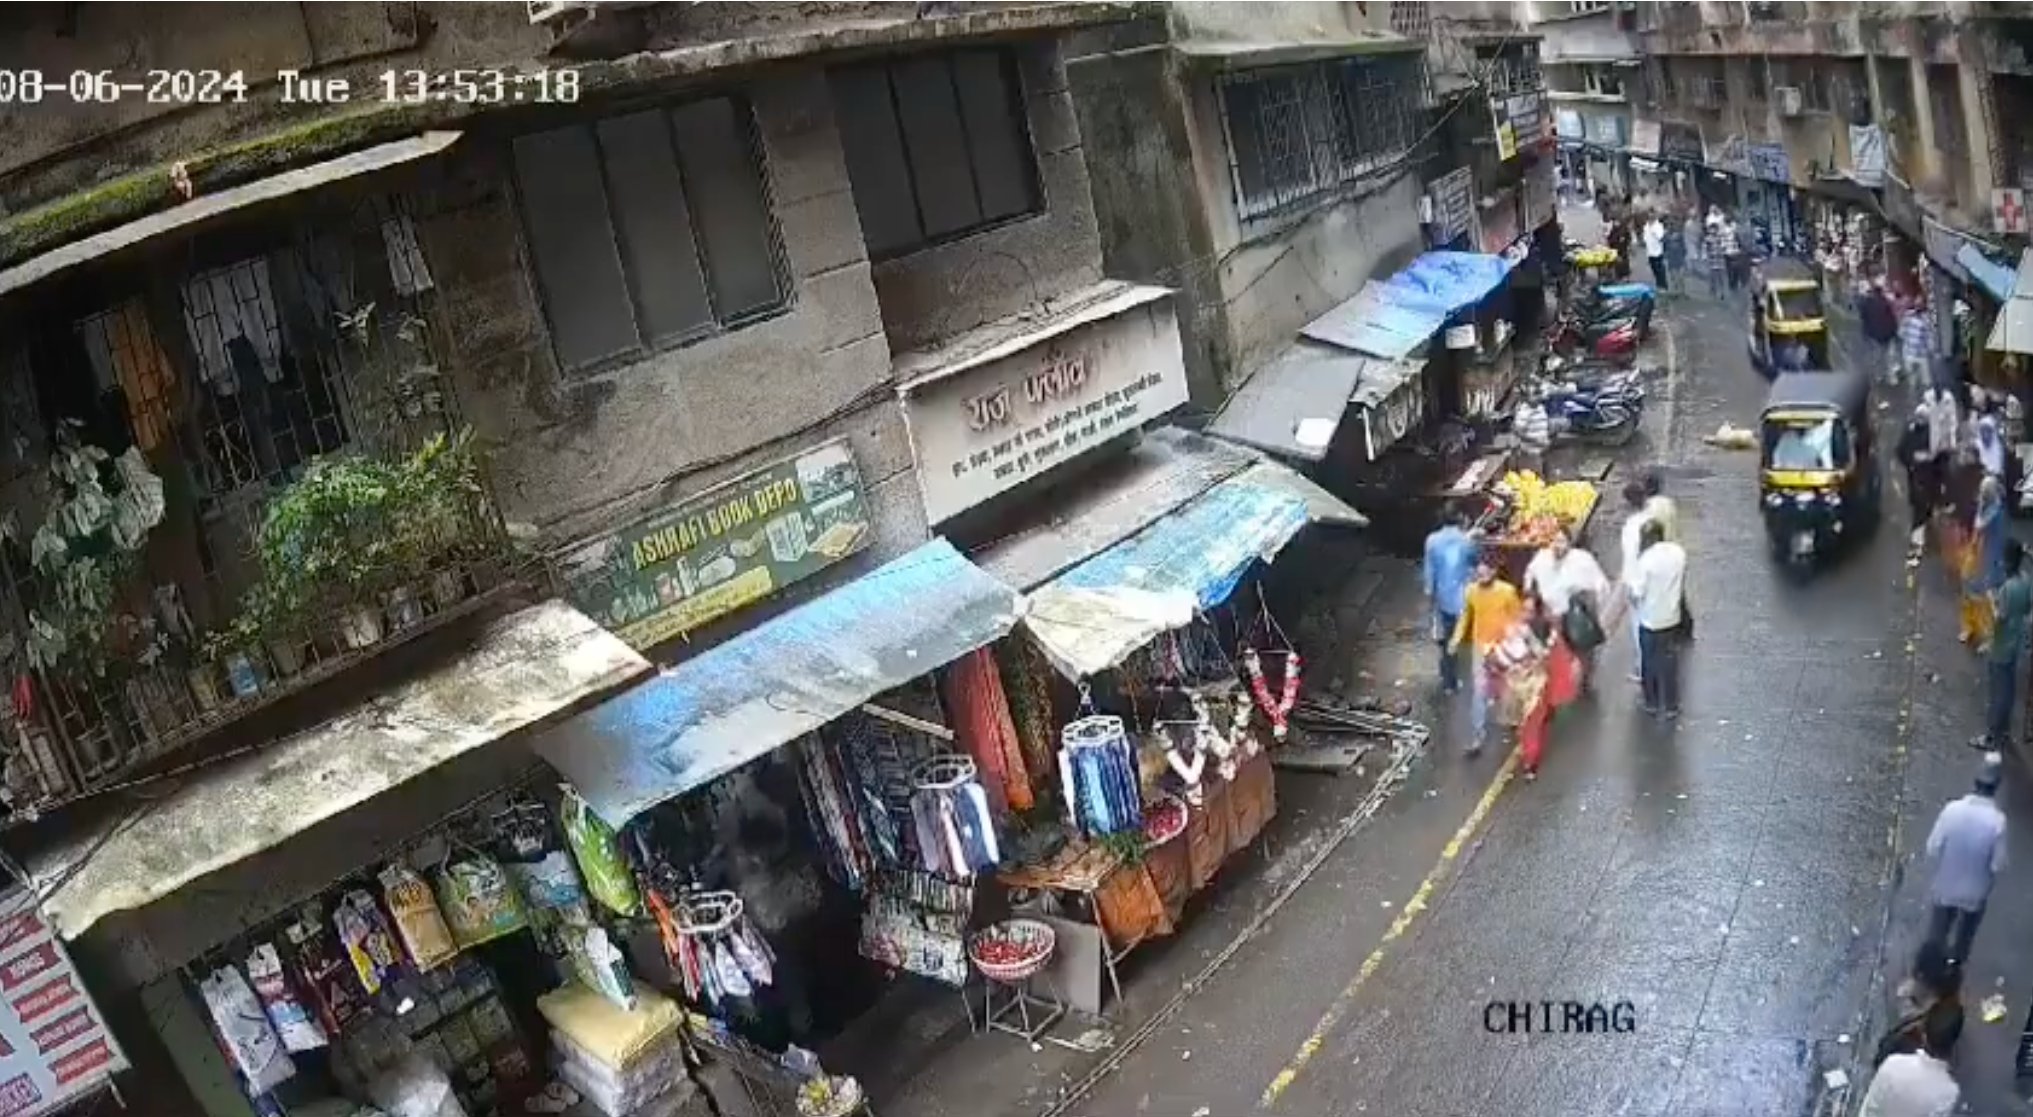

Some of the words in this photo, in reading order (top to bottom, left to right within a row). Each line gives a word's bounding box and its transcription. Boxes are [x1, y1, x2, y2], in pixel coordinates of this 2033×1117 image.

[631, 515, 707, 571] ASHRAFI
[706, 495, 753, 536] BOOK
[754, 477, 797, 517] DEPO
